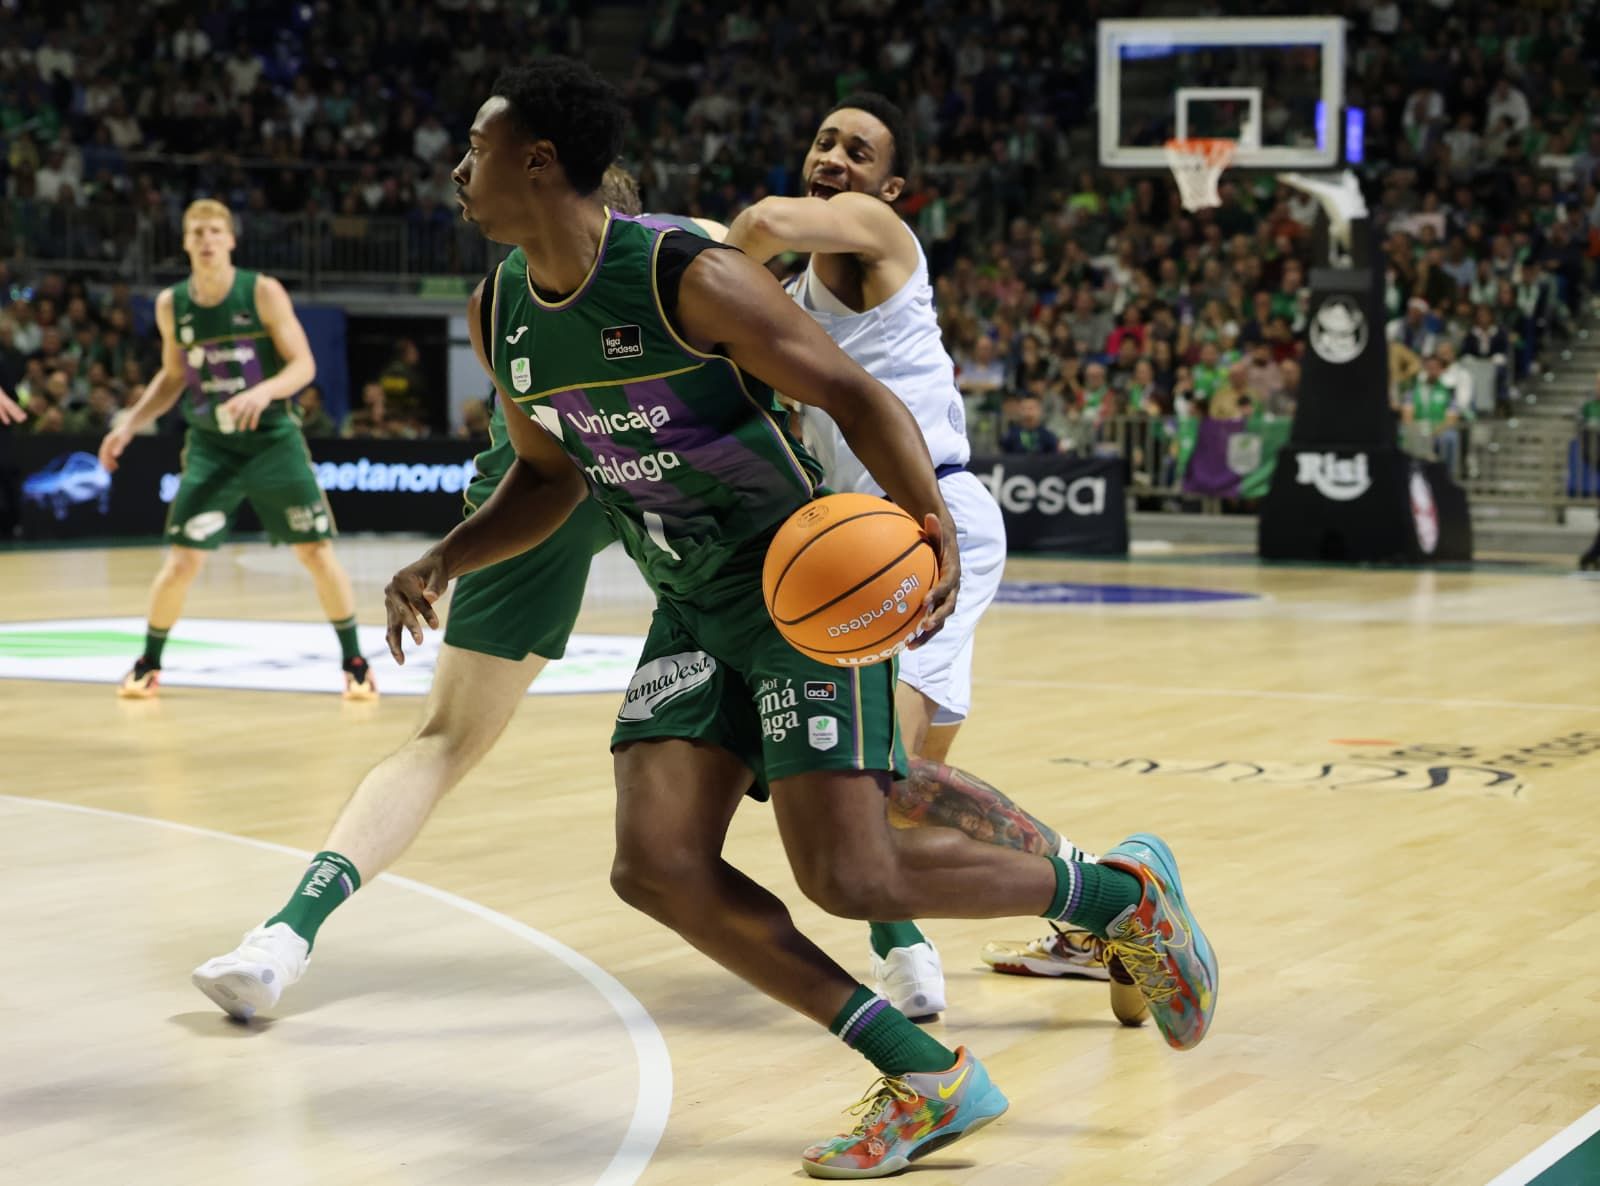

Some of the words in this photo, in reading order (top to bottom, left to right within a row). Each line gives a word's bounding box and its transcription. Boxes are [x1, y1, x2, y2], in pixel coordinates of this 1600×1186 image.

[605, 337, 621, 348] liga
[607, 344, 639, 355] endesa
[567, 404, 671, 435] Unicaja
[625, 656, 711, 705] amadesa
[807, 689, 829, 698] acb
